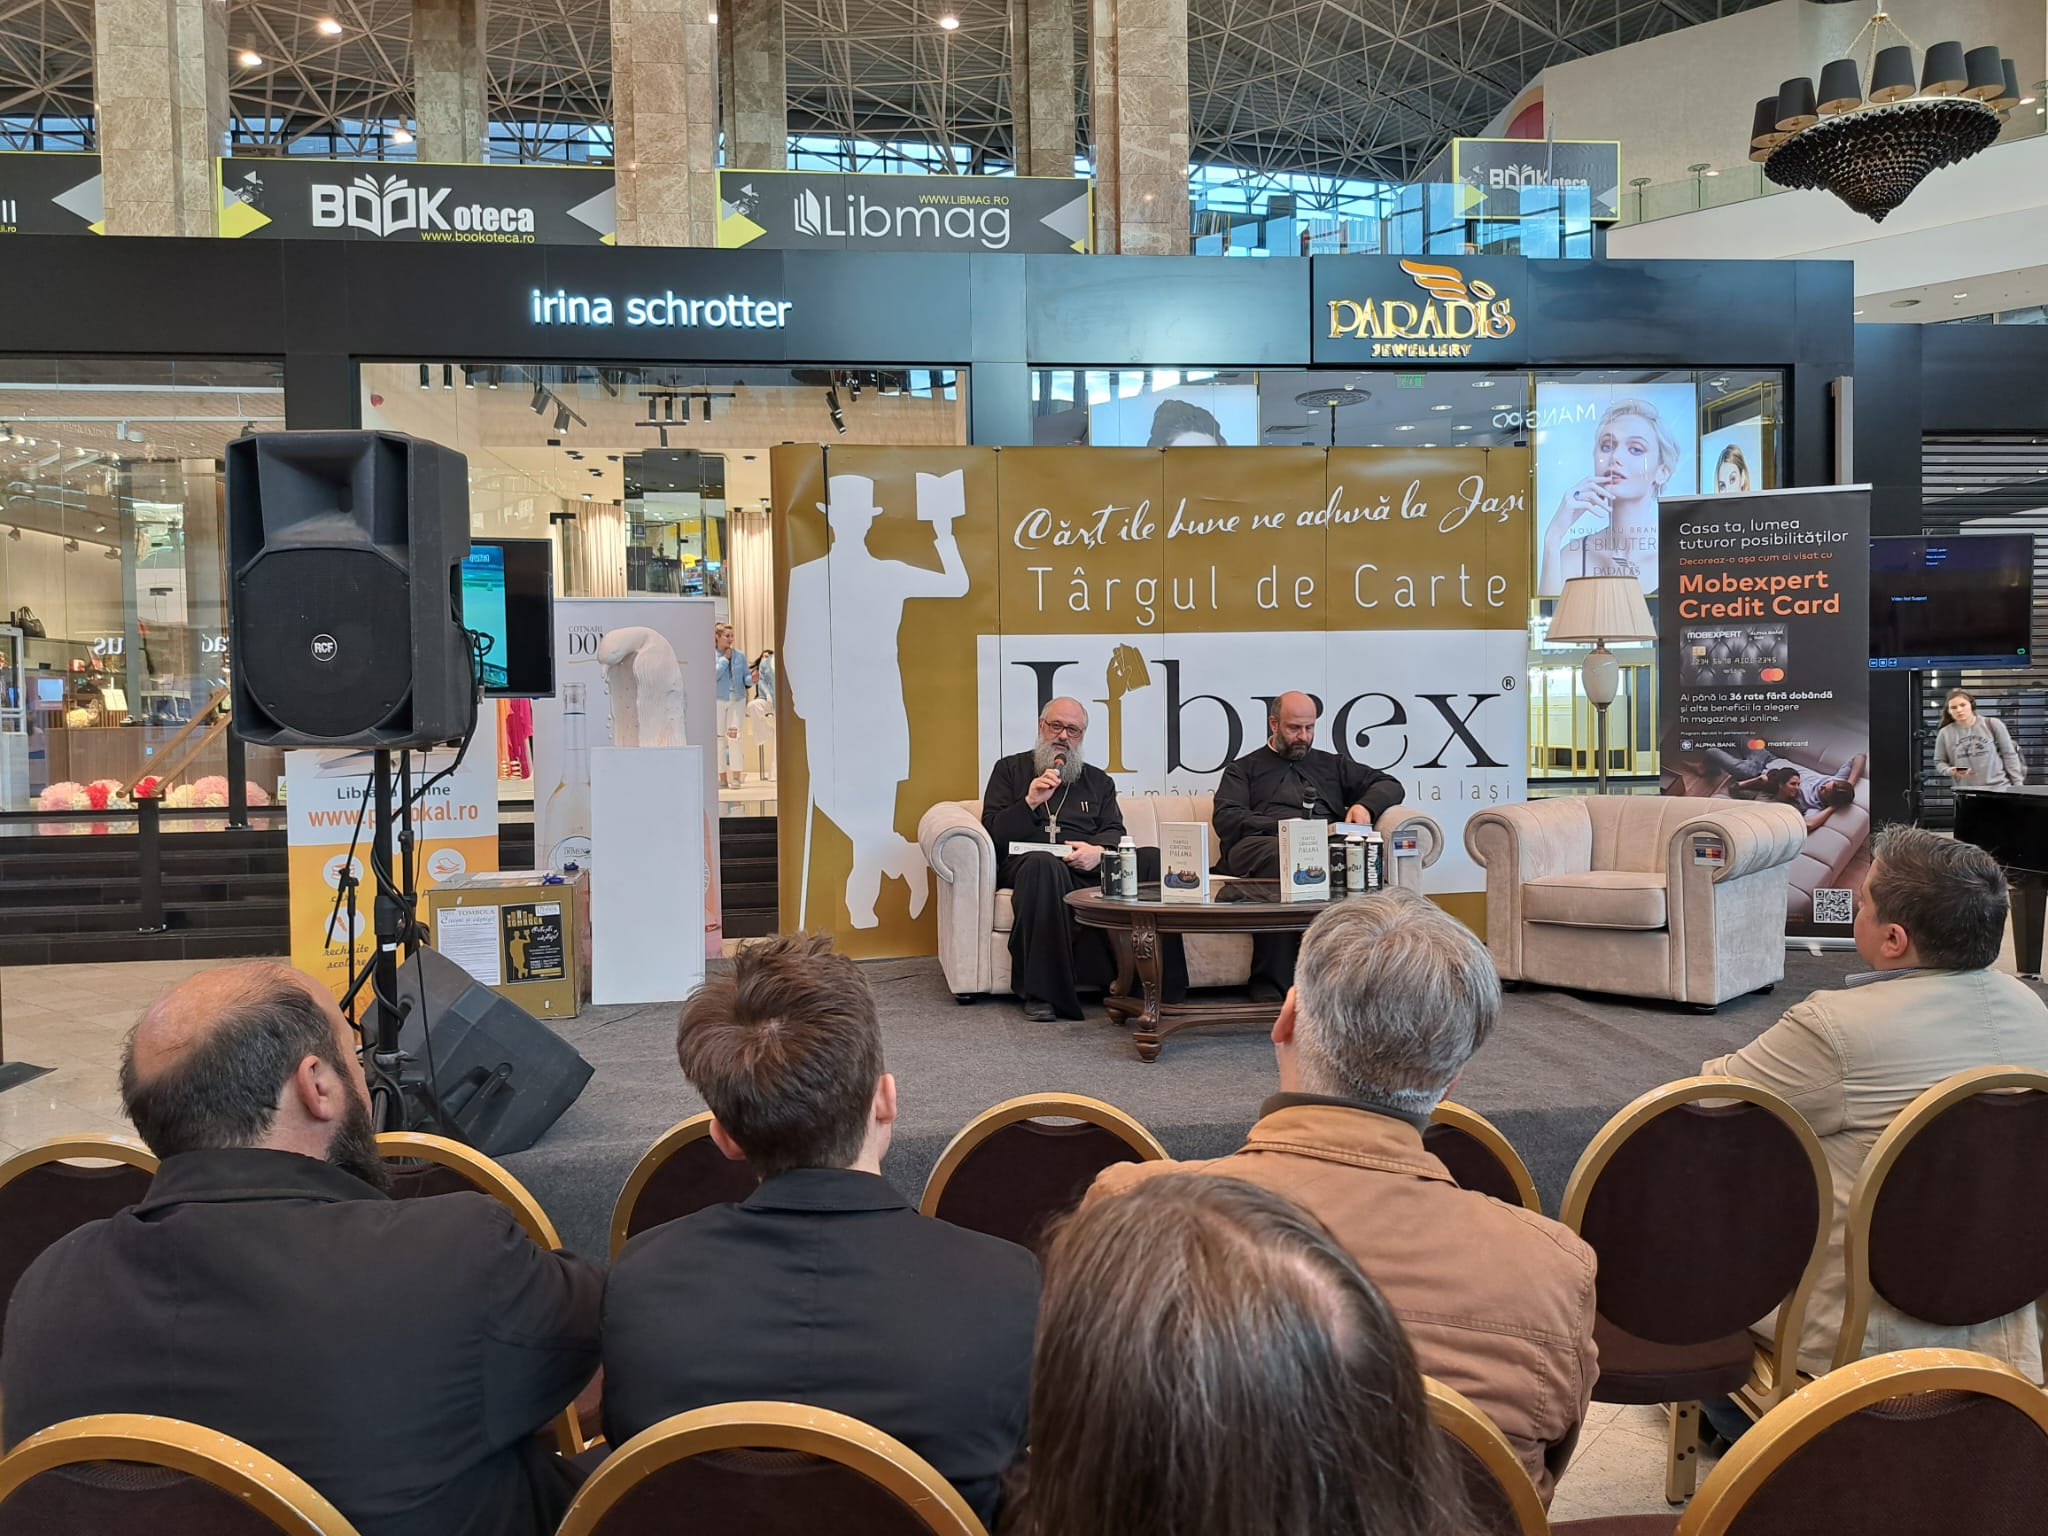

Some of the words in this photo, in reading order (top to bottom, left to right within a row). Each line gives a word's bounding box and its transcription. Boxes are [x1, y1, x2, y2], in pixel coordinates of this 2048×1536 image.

[918, 194, 1010, 206] WWW.LIBMAG.RO
[824, 193, 1011, 249] Libmag
[420, 230, 535, 244] www.bookoteca.ro
[531, 289, 614, 325] irina
[626, 290, 793, 328] schrotter
[1371, 342, 1472, 358] JEWELLERY
[1251, 513, 1286, 530] ne
[1296, 485, 1391, 530] adună
[1400, 479, 1428, 520] la
[1629, 526, 1657, 534] BRAN
[1679, 523, 1720, 536] Casa
[1723, 521, 1746, 535] ta,
[1750, 518, 1800, 532] lumea
[1594, 537, 1657, 552] BIJUTER
[1679, 537, 1737, 550] tuturor
[1679, 556, 1736, 566] Decoreaz-o
[1758, 554, 1780, 563] cum
[1782, 552, 1791, 561] ai
[1793, 551, 1819, 561] visat
[1820, 551, 1833, 560] cu
[1679, 569, 1830, 596] Mobexpert
[1027, 564, 1218, 627] Târgul
[1256, 564, 1315, 609] de
[1354, 563, 1507, 608] Carte
[1678, 596, 1766, 619] Credit
[1771, 592, 1841, 616] Card
[313, 642, 334, 654] RCF
[569, 632, 604, 656] DO
[1679, 693, 1690, 701] Ai
[1729, 692, 1742, 701] 36
[1743, 692, 1765, 701] rate
[1689, 703, 1709, 713] alte
[1710, 703, 1751, 712] beneficii
[1752, 702, 1762, 711] la
[1763, 703, 1800, 714] alegere
[1691, 715, 1738, 725] magazine
[1749, 713, 1781, 723] online.
[1694, 741, 1717, 749] ALPHA
[1416, 781, 1442, 801] la
[1367, 843, 1379, 887] MONTANA
